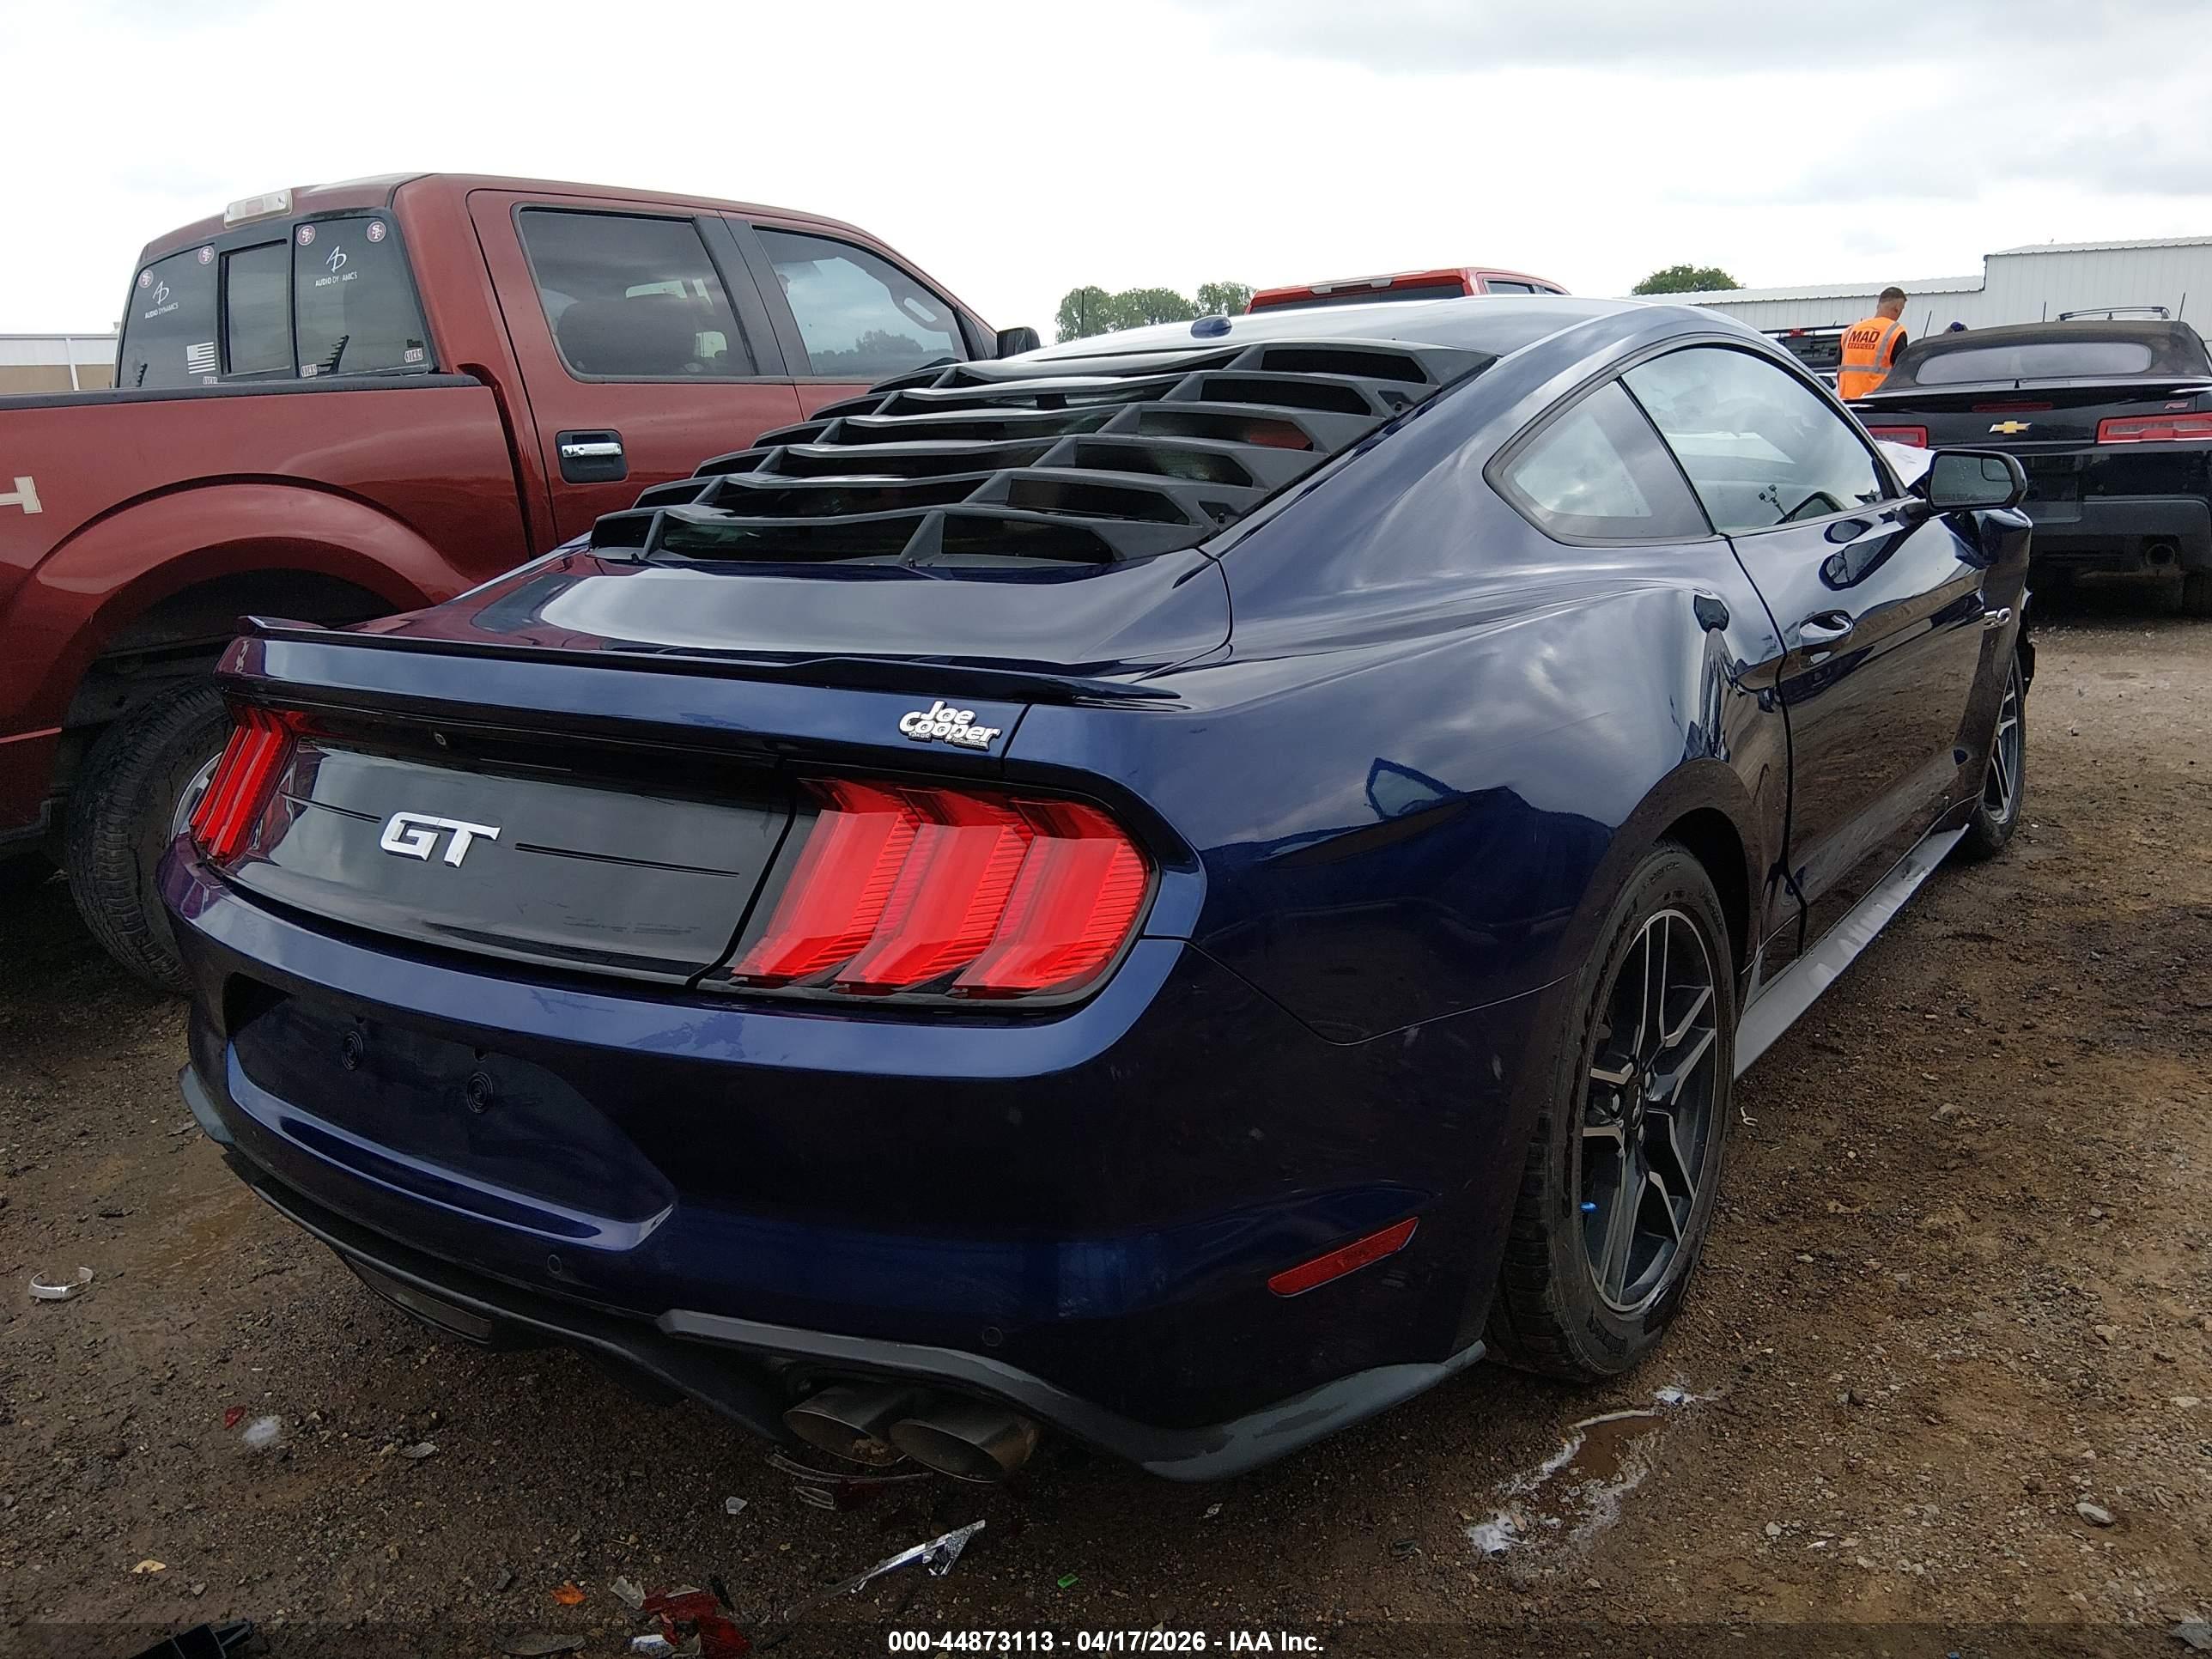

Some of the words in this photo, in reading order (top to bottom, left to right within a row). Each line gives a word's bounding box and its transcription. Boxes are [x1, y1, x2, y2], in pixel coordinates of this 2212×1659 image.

[315, 277, 332, 287] AUDIO
[1848, 330, 1881, 343] MAD
[919, 701, 976, 726] Joe
[899, 711, 1002, 743] Cooper
[380, 811, 502, 868] GT
